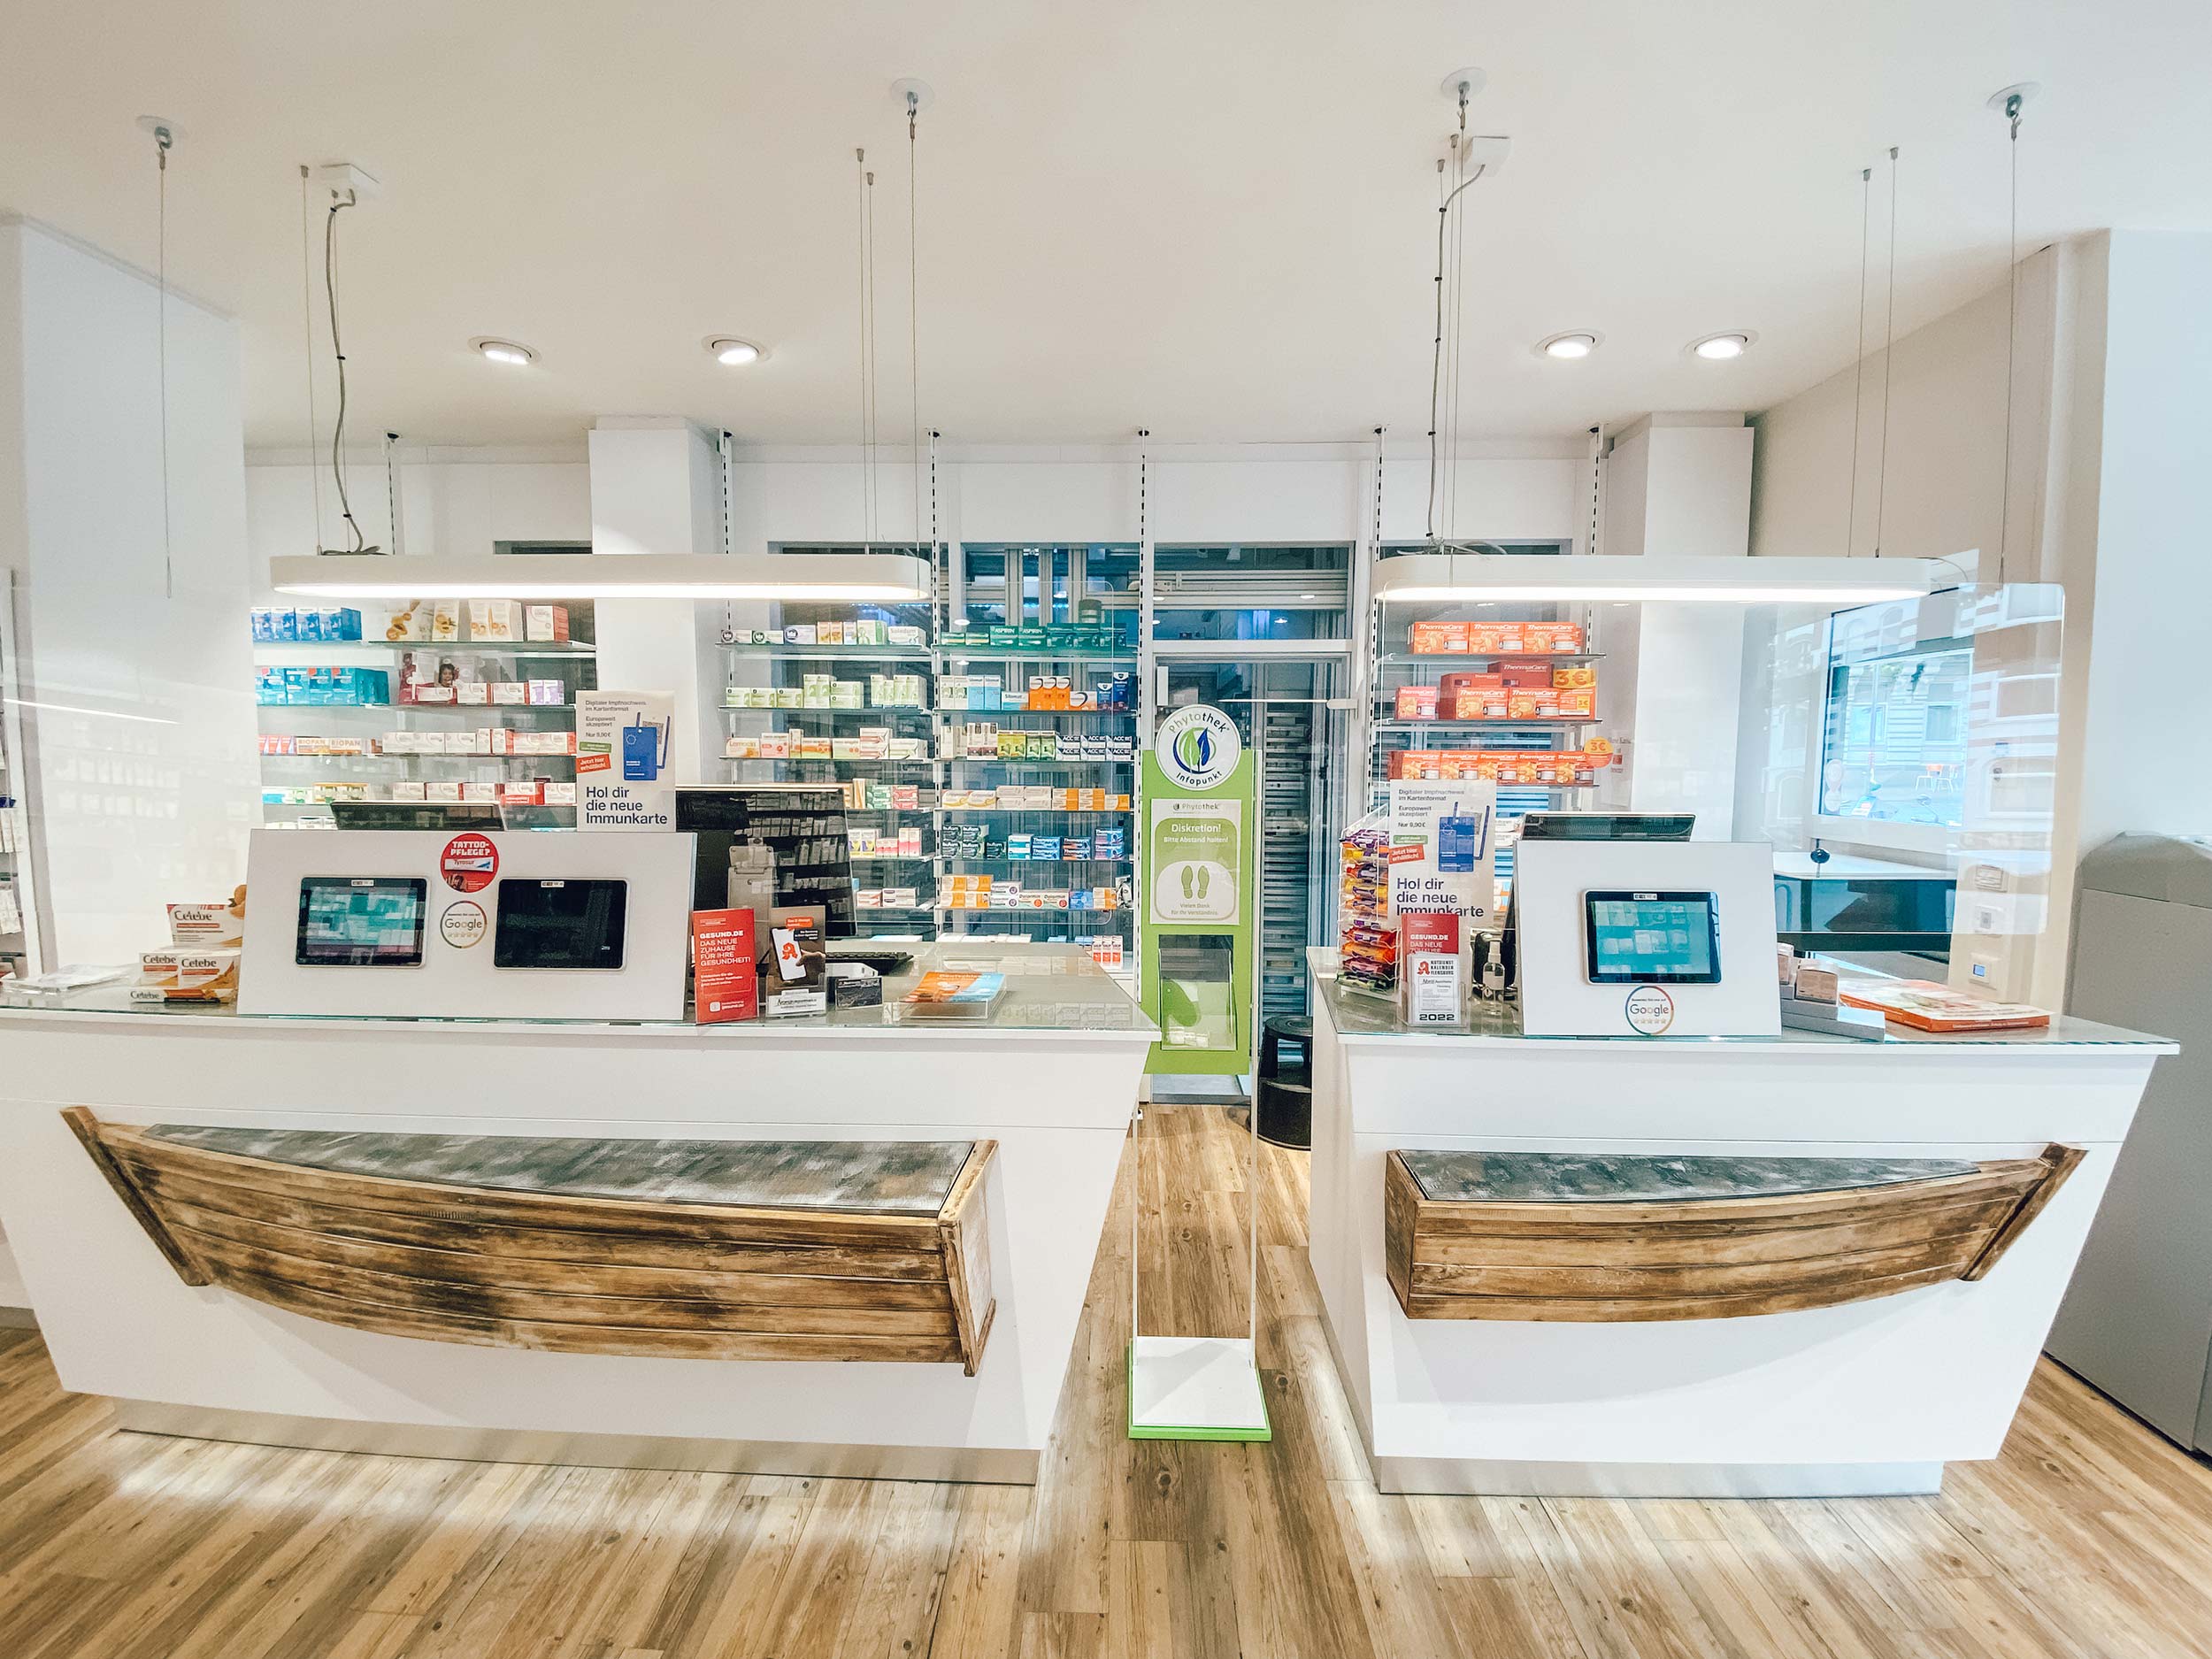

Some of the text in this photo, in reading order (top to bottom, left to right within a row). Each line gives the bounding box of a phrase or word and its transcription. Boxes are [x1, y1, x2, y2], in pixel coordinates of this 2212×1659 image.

[1169, 712, 1227, 733] Phytothek
[1176, 771, 1222, 786] Infopunkt
[586, 786, 629, 798] Hol dir
[586, 800, 643, 811] die neue
[586, 813, 667, 824] Immunkarte
[1171, 824, 1221, 832] Diskretion!
[1397, 878, 1444, 889] Hol dir
[1397, 891, 1458, 903] die neue
[174, 910, 212, 921] Cetebe
[1397, 905, 1484, 917] Immunkarte
[445, 918, 482, 931] Google
[700, 930, 743, 939] GESUND.DE
[700, 945, 736, 954] ZUHAUSE
[143, 955, 177, 964] Cetebe
[181, 959, 217, 968] Cetebe
[700, 957, 751, 966] GESUNDHEIT!
[130, 991, 159, 999] Cetebe
[1630, 1004, 1669, 1017] Google
